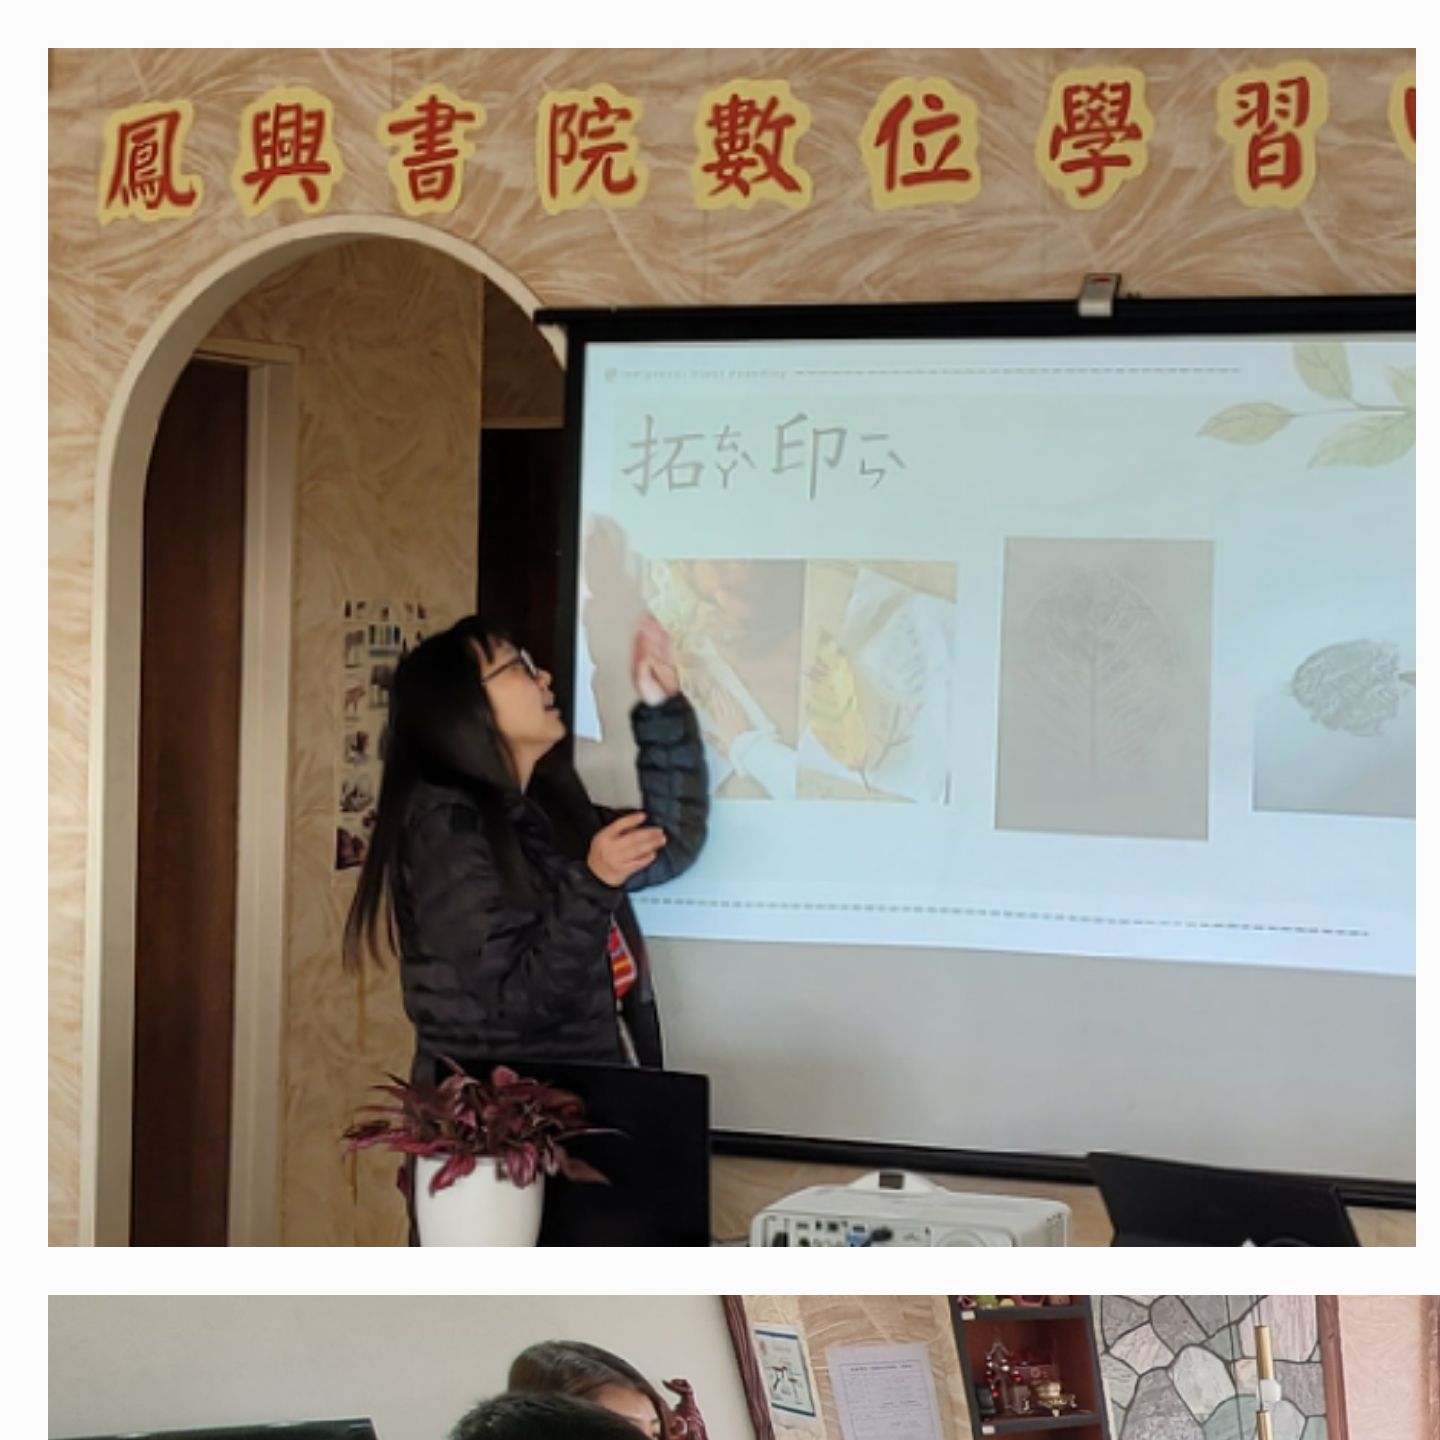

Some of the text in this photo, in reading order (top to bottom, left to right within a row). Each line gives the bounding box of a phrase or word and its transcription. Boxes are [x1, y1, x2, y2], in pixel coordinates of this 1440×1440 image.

[104, 76, 1416, 210] 鳳興書院數位學習
